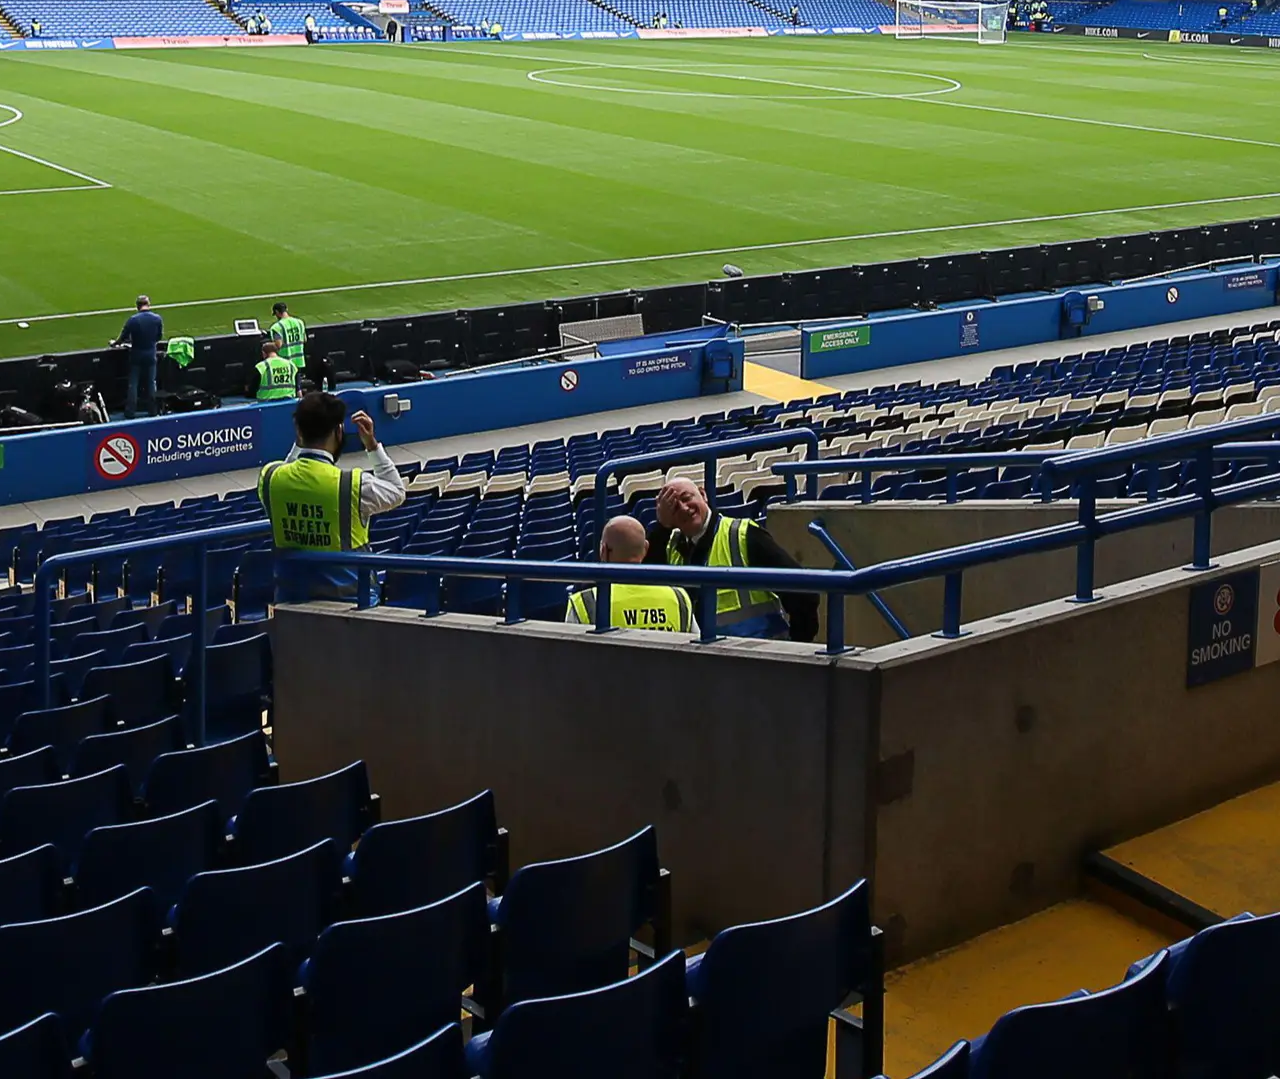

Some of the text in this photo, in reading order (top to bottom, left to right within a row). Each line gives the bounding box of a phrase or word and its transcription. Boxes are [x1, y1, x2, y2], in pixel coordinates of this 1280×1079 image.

[1084, 28, 1118, 38] NIKE.COM
[1181, 32, 1208, 43] KE.COM
[821, 337, 859, 348] ACCESS ONLY
[822, 330, 858, 341] EMERGENCY
[656, 356, 678, 364] OFFENCE
[670, 362, 686, 370] PITCH
[272, 366, 289, 376] PRESS
[147, 425, 253, 454] NO SMOKING
[147, 441, 253, 465] Including e-Cigarettes
[286, 503, 323, 519] W 615
[281, 518, 330, 534] SAFETY
[283, 530, 331, 547] STEWARD
[624, 609, 666, 625] W 785
[1212, 619, 1231, 640] NO
[1191, 634, 1251, 666] SMOKING
